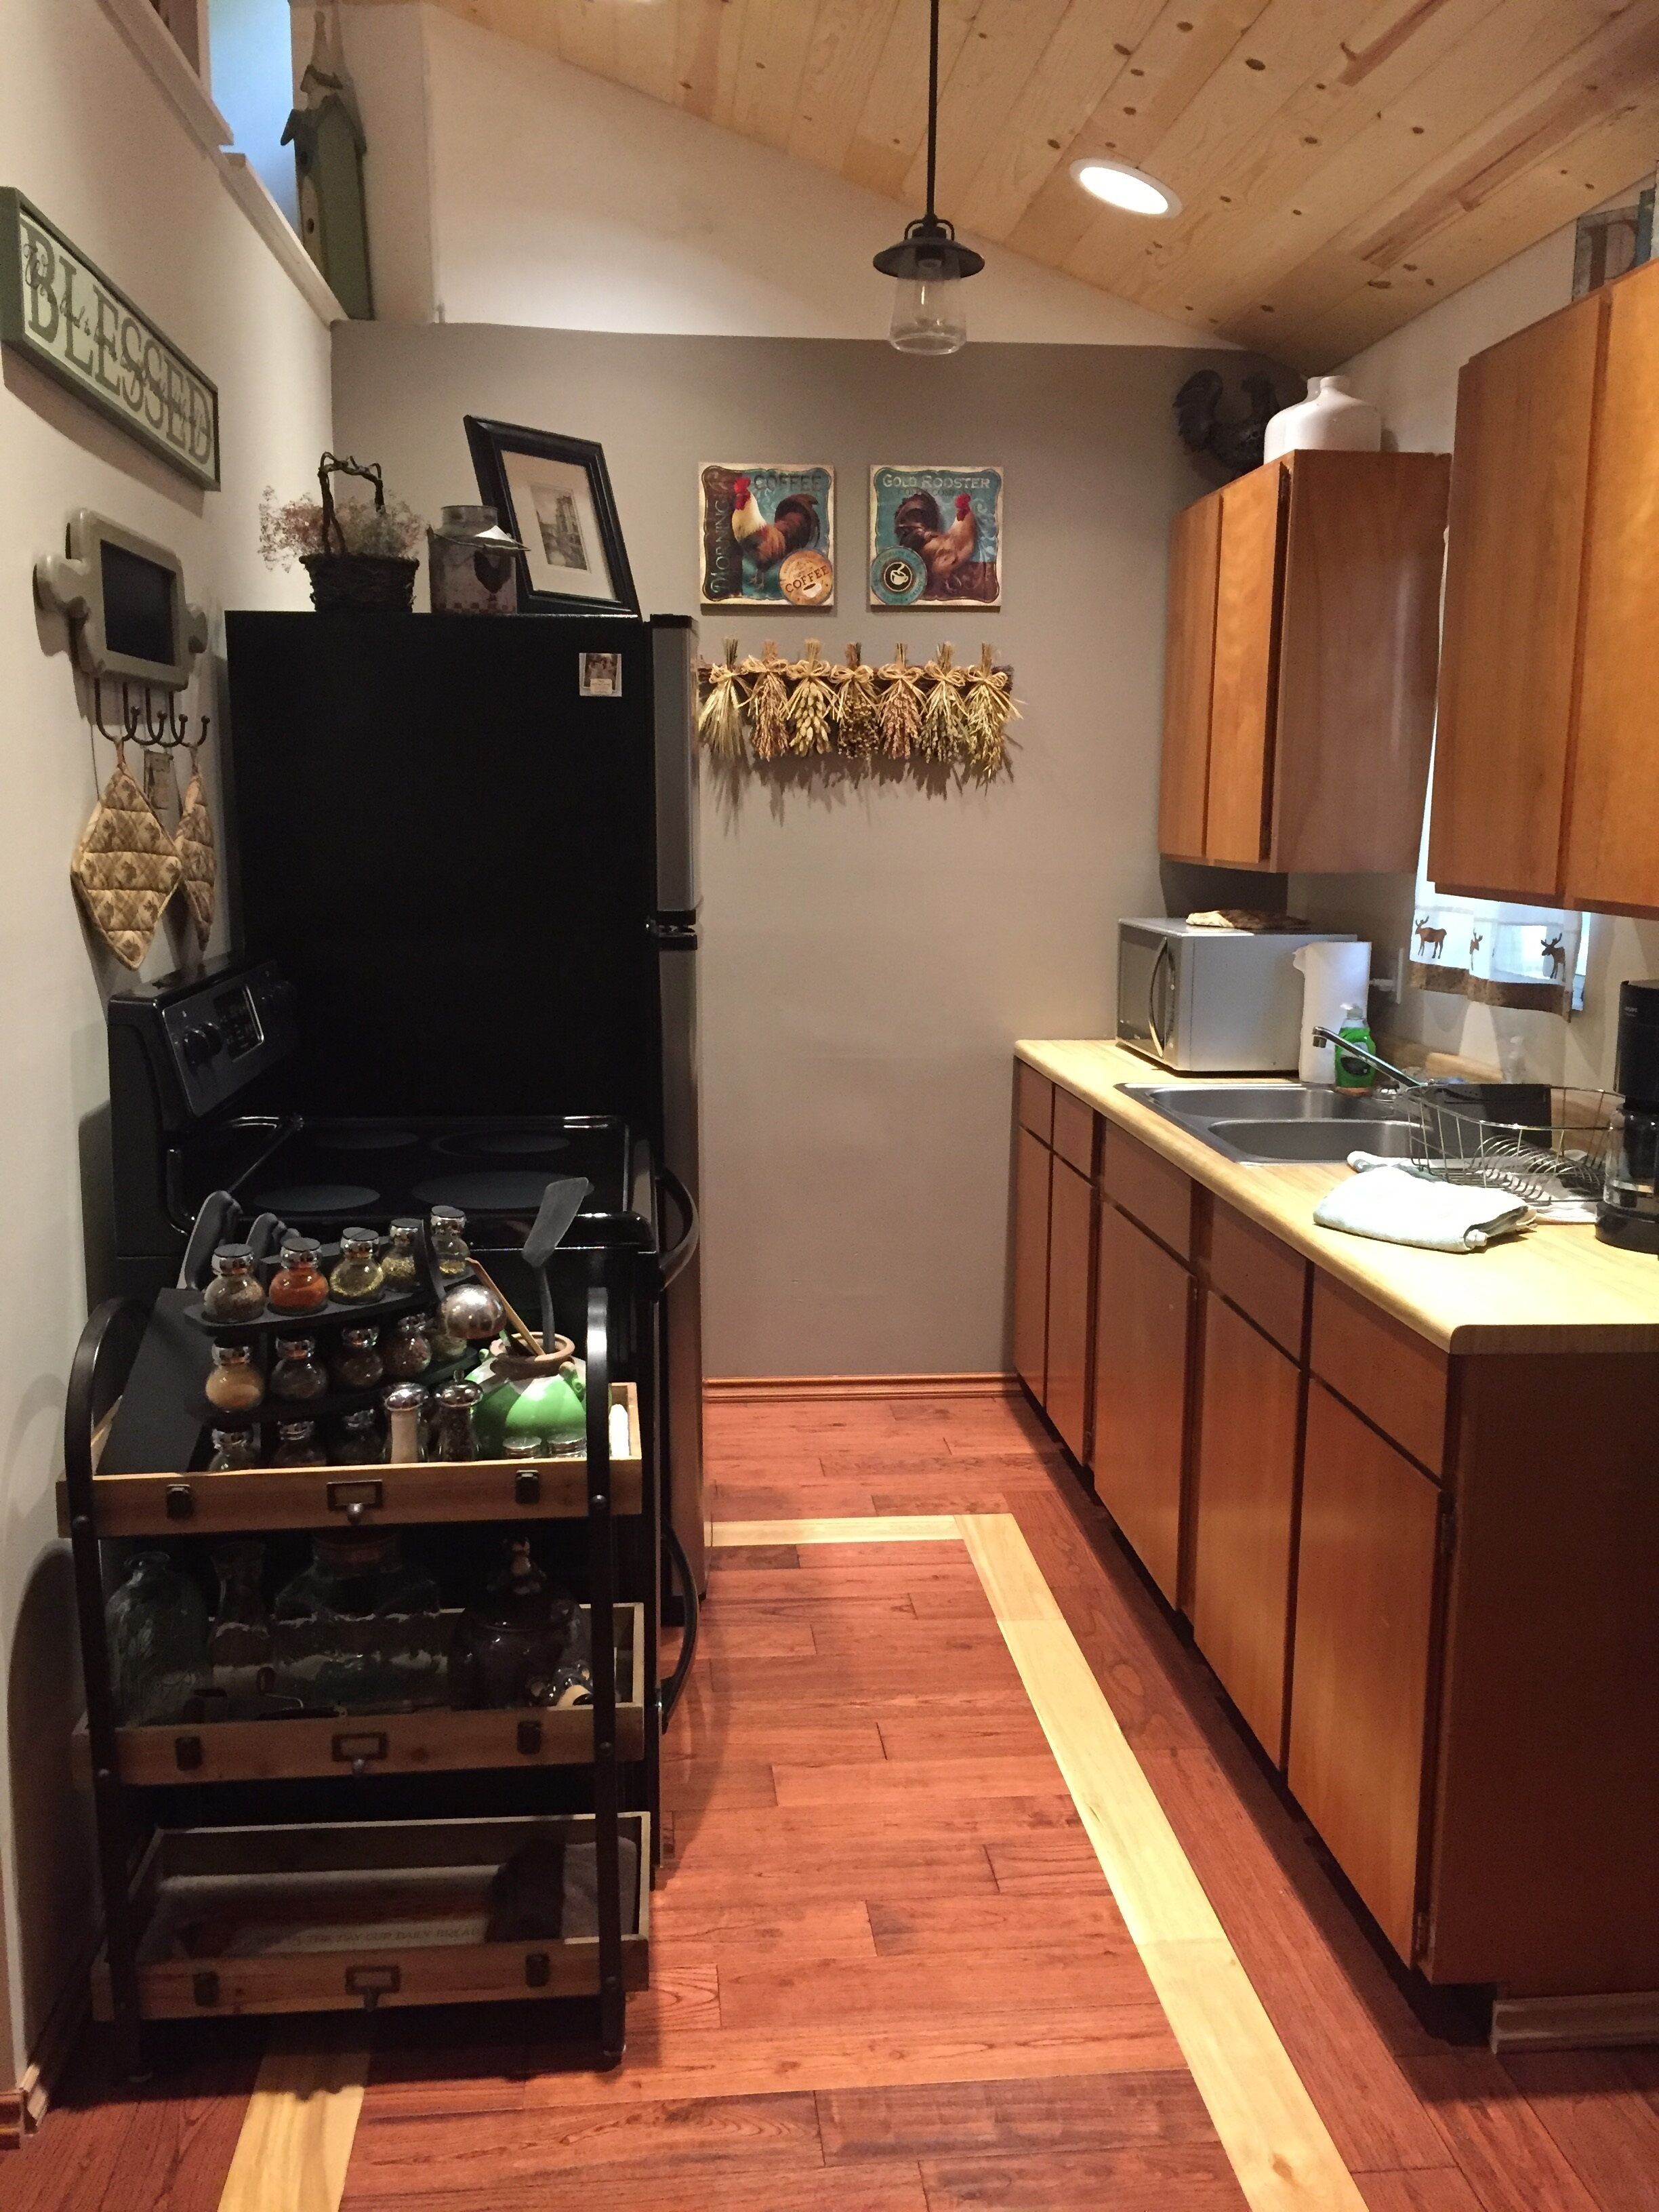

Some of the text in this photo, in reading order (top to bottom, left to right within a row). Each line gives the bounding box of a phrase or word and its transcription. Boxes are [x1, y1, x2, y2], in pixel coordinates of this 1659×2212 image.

[20, 216, 211, 465] BLESSED
[754, 474, 822, 491] COFFEE
[882, 474, 990, 489] GOLD ROOSTER
[785, 565, 830, 592] COFFEE
